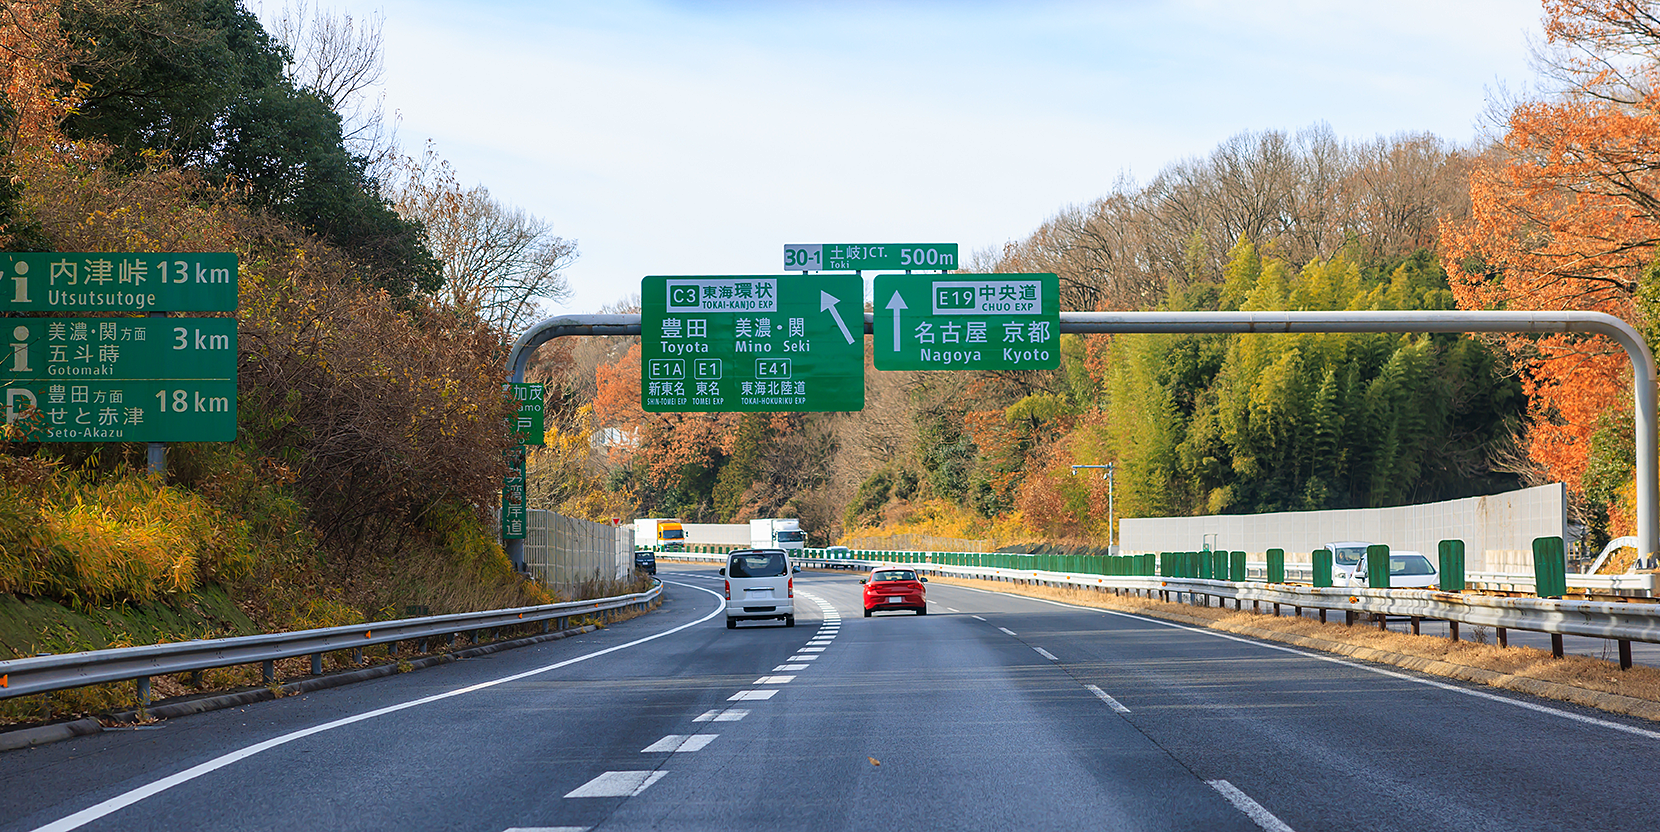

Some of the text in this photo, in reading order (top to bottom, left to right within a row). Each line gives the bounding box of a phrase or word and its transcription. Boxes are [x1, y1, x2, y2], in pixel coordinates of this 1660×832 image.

[51, 259, 228, 285] 内津峠 13 km
[49, 290, 155, 309] Utsutsutoge
[674, 282, 772, 302] C3 東海環状
[940, 284, 1037, 305] E19 中央道
[702, 300, 773, 310] TOKAI-KANJO EXP
[982, 303, 1033, 311] CHUO EXP
[661, 318, 706, 338] 豊田
[915, 321, 1050, 343] 名古屋 京都
[173, 328, 228, 349] 3 km
[736, 340, 809, 352] Mino Seki
[49, 344, 119, 362] 五斗蒔
[661, 342, 708, 355] Toyota
[920, 348, 1049, 365] Nagoya Kyoto
[48, 364, 112, 375] Gotomaki
[653, 363, 681, 375] E1A
[700, 363, 715, 375] E1
[760, 363, 786, 374] E41
[48, 385, 122, 403] 豊田方面
[649, 382, 684, 395] 新東名
[696, 381, 719, 395] 東名
[741, 381, 806, 396] 東海北陸道
[156, 390, 228, 412] 18 km
[516, 404, 541, 412] amo
[47, 407, 144, 425] せと赤津
[48, 427, 123, 438] Seto-Akazu
